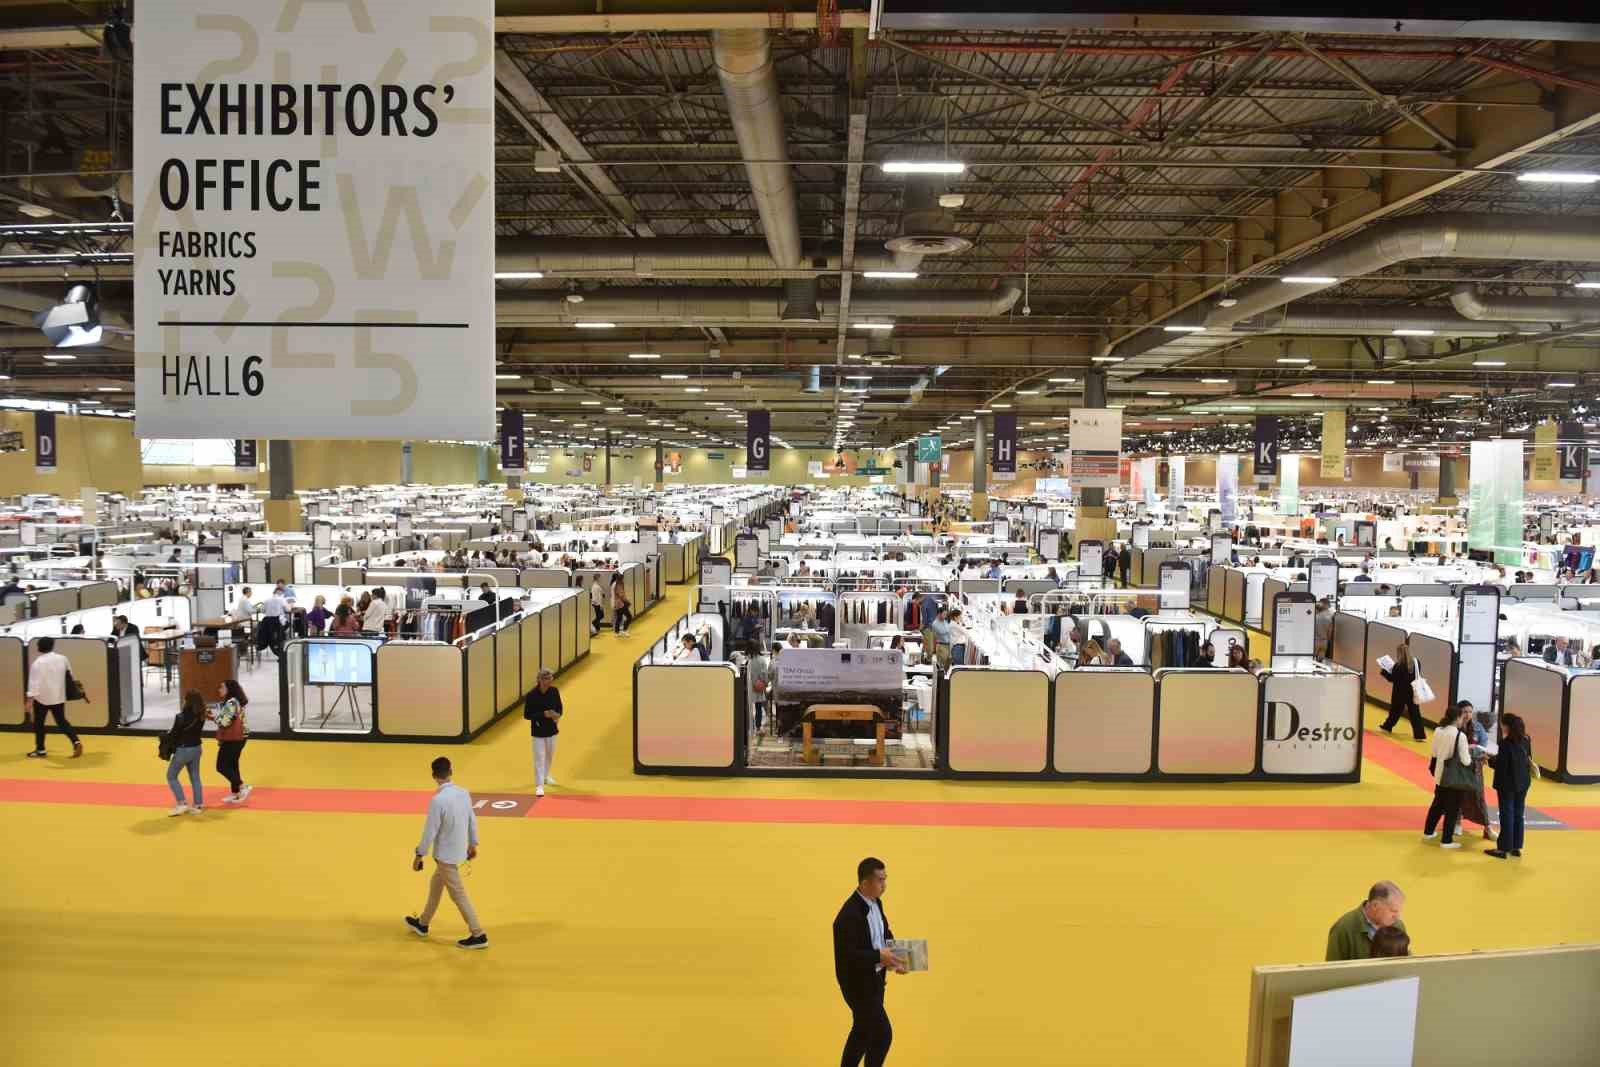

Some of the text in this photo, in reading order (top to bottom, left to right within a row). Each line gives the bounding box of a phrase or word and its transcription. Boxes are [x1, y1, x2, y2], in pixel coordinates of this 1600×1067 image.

[159, 158, 321, 212] OFFICE
[158, 231, 257, 259] FABRICS
[158, 268, 236, 296] YARNS
[40, 435, 52, 455] D
[241, 440, 250, 455] E
[508, 436, 518, 456] F
[752, 437, 764, 458] G
[999, 440, 1010, 460] H
[1260, 442, 1272, 463] K
[1567, 446, 1577, 467] K
[1264, 701, 1357, 742] Destro
